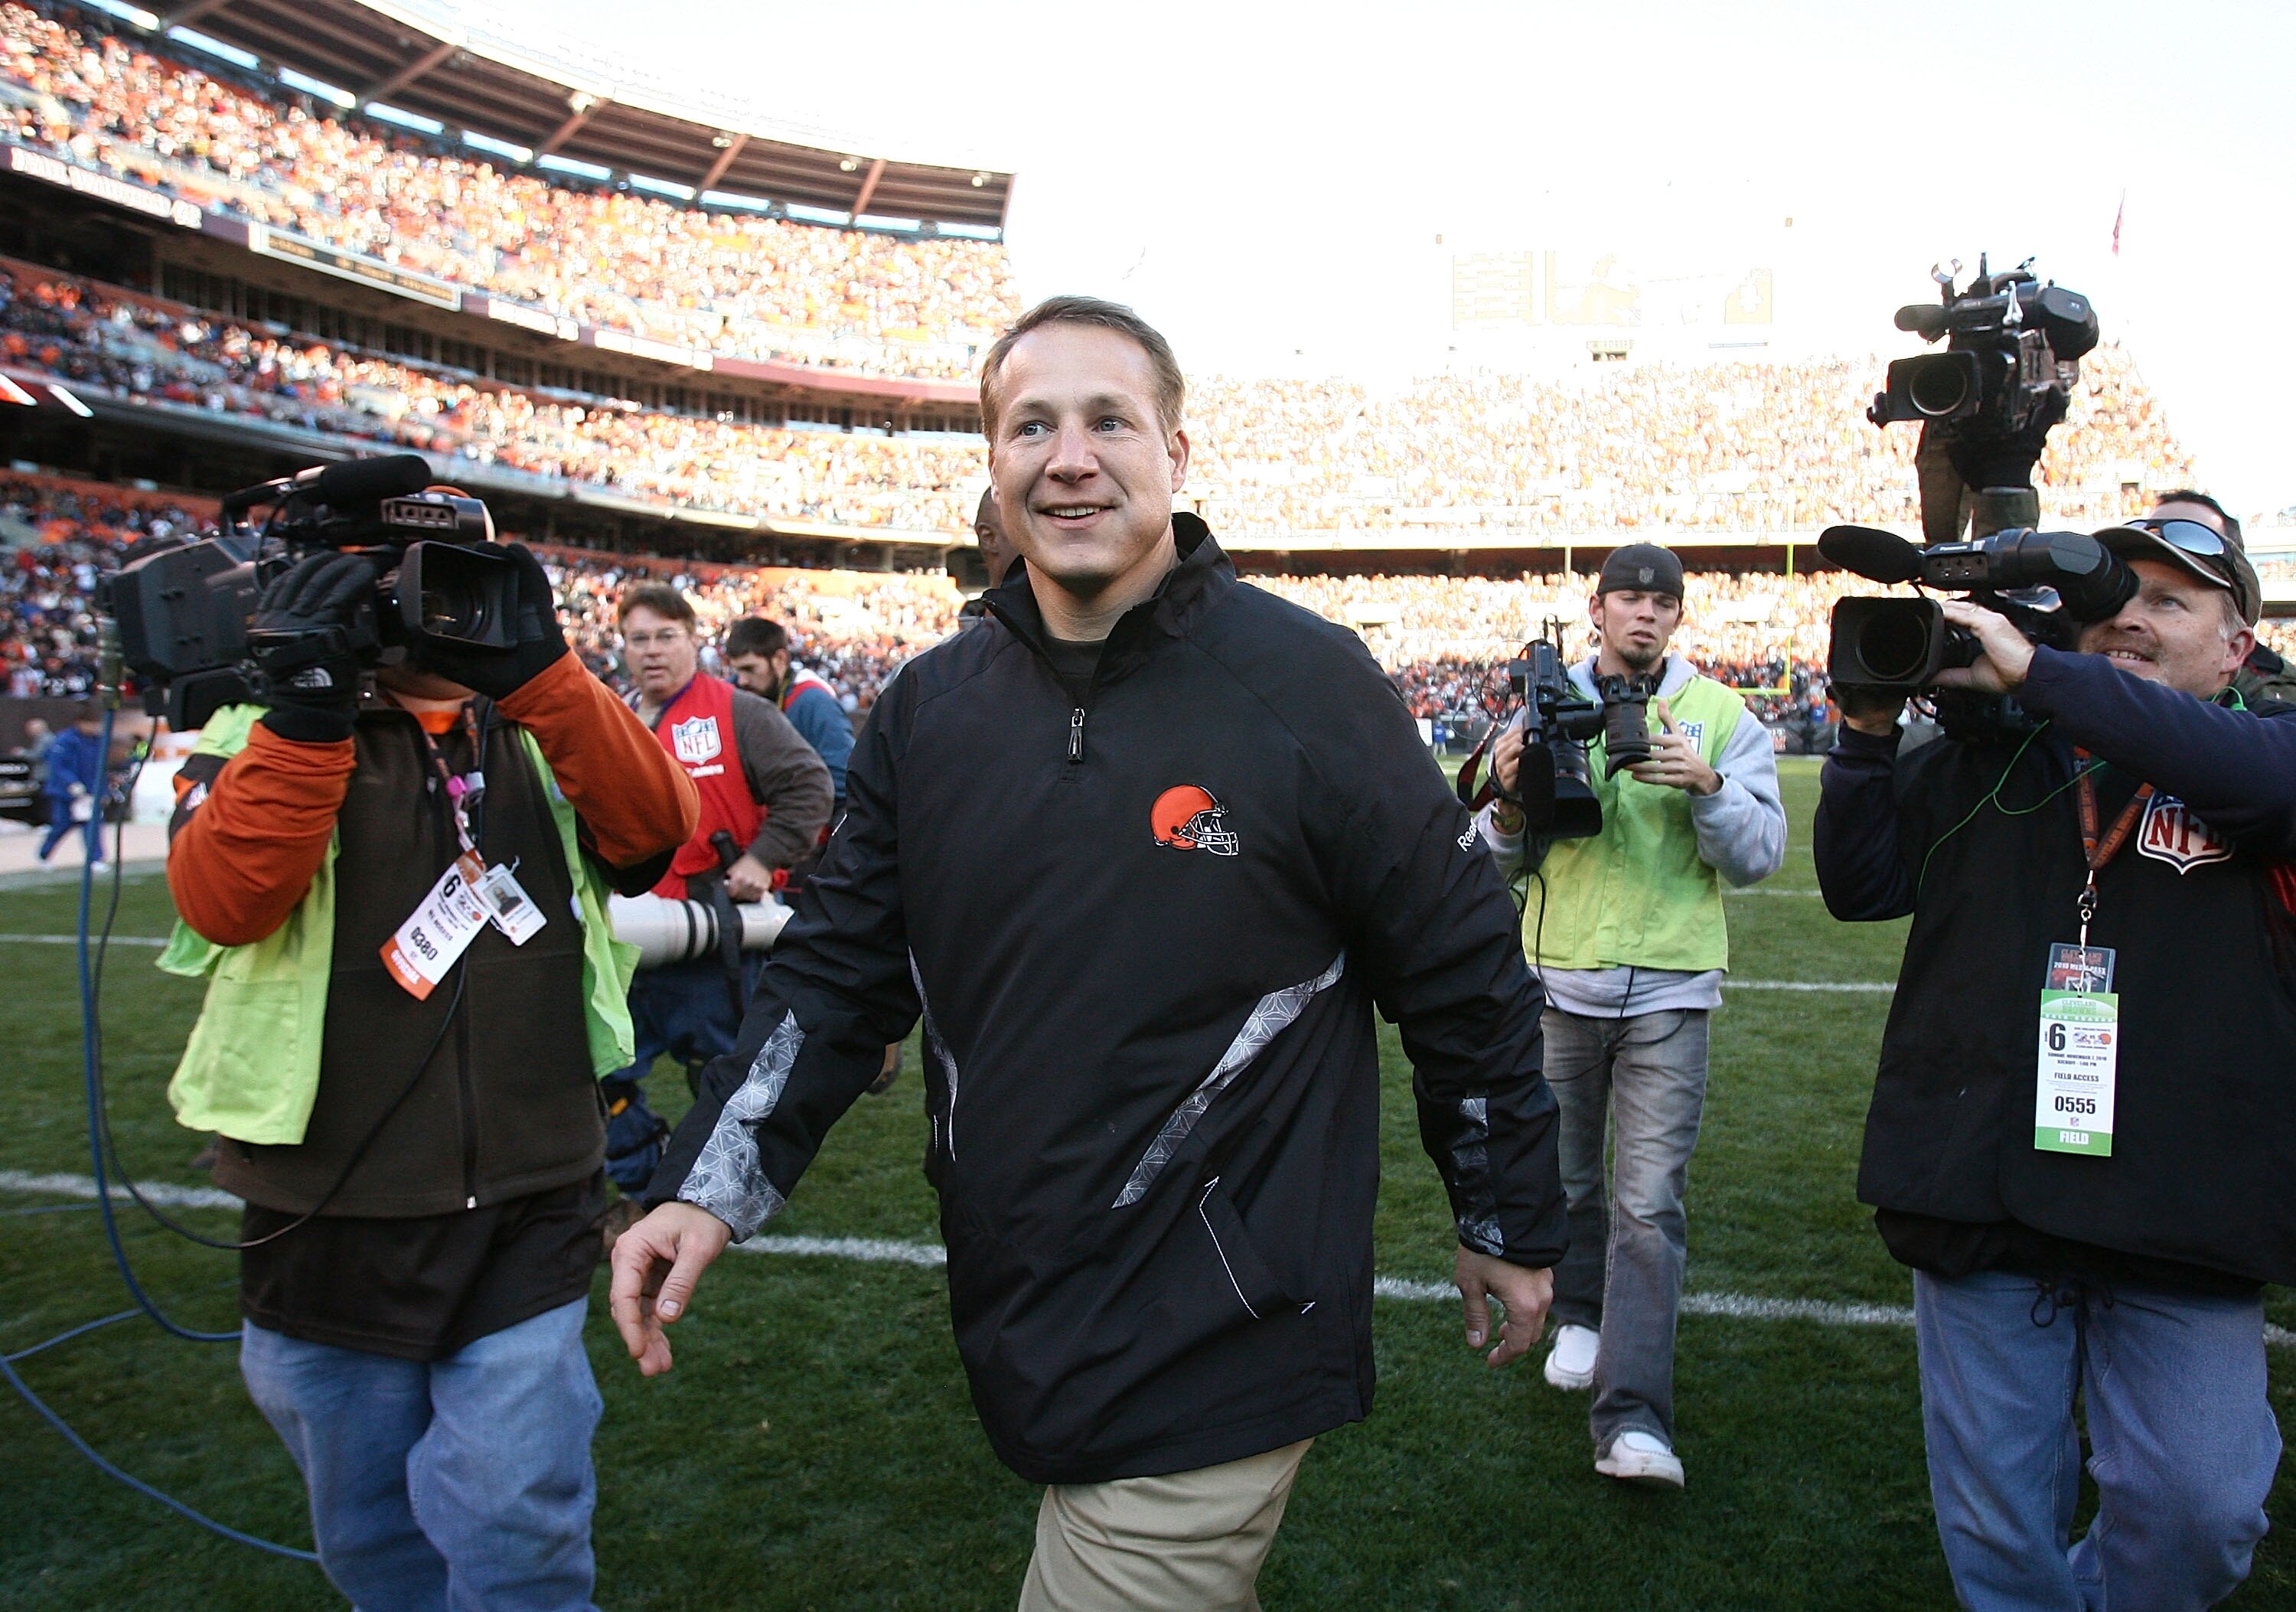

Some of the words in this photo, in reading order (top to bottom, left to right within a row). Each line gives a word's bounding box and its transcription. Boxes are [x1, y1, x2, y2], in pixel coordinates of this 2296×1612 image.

[683, 733, 716, 755] NFL
[2148, 808, 2223, 856] NFL
[442, 874, 461, 898] 6
[410, 926, 439, 961] 0380
[2049, 1023, 2066, 1051] 6
[2054, 1072, 2072, 1080] FIELD
[2073, 1073, 2099, 1082] ACCESS
[2055, 1095, 2096, 1114] 0555
[2060, 1131, 2089, 1144] FIELD
